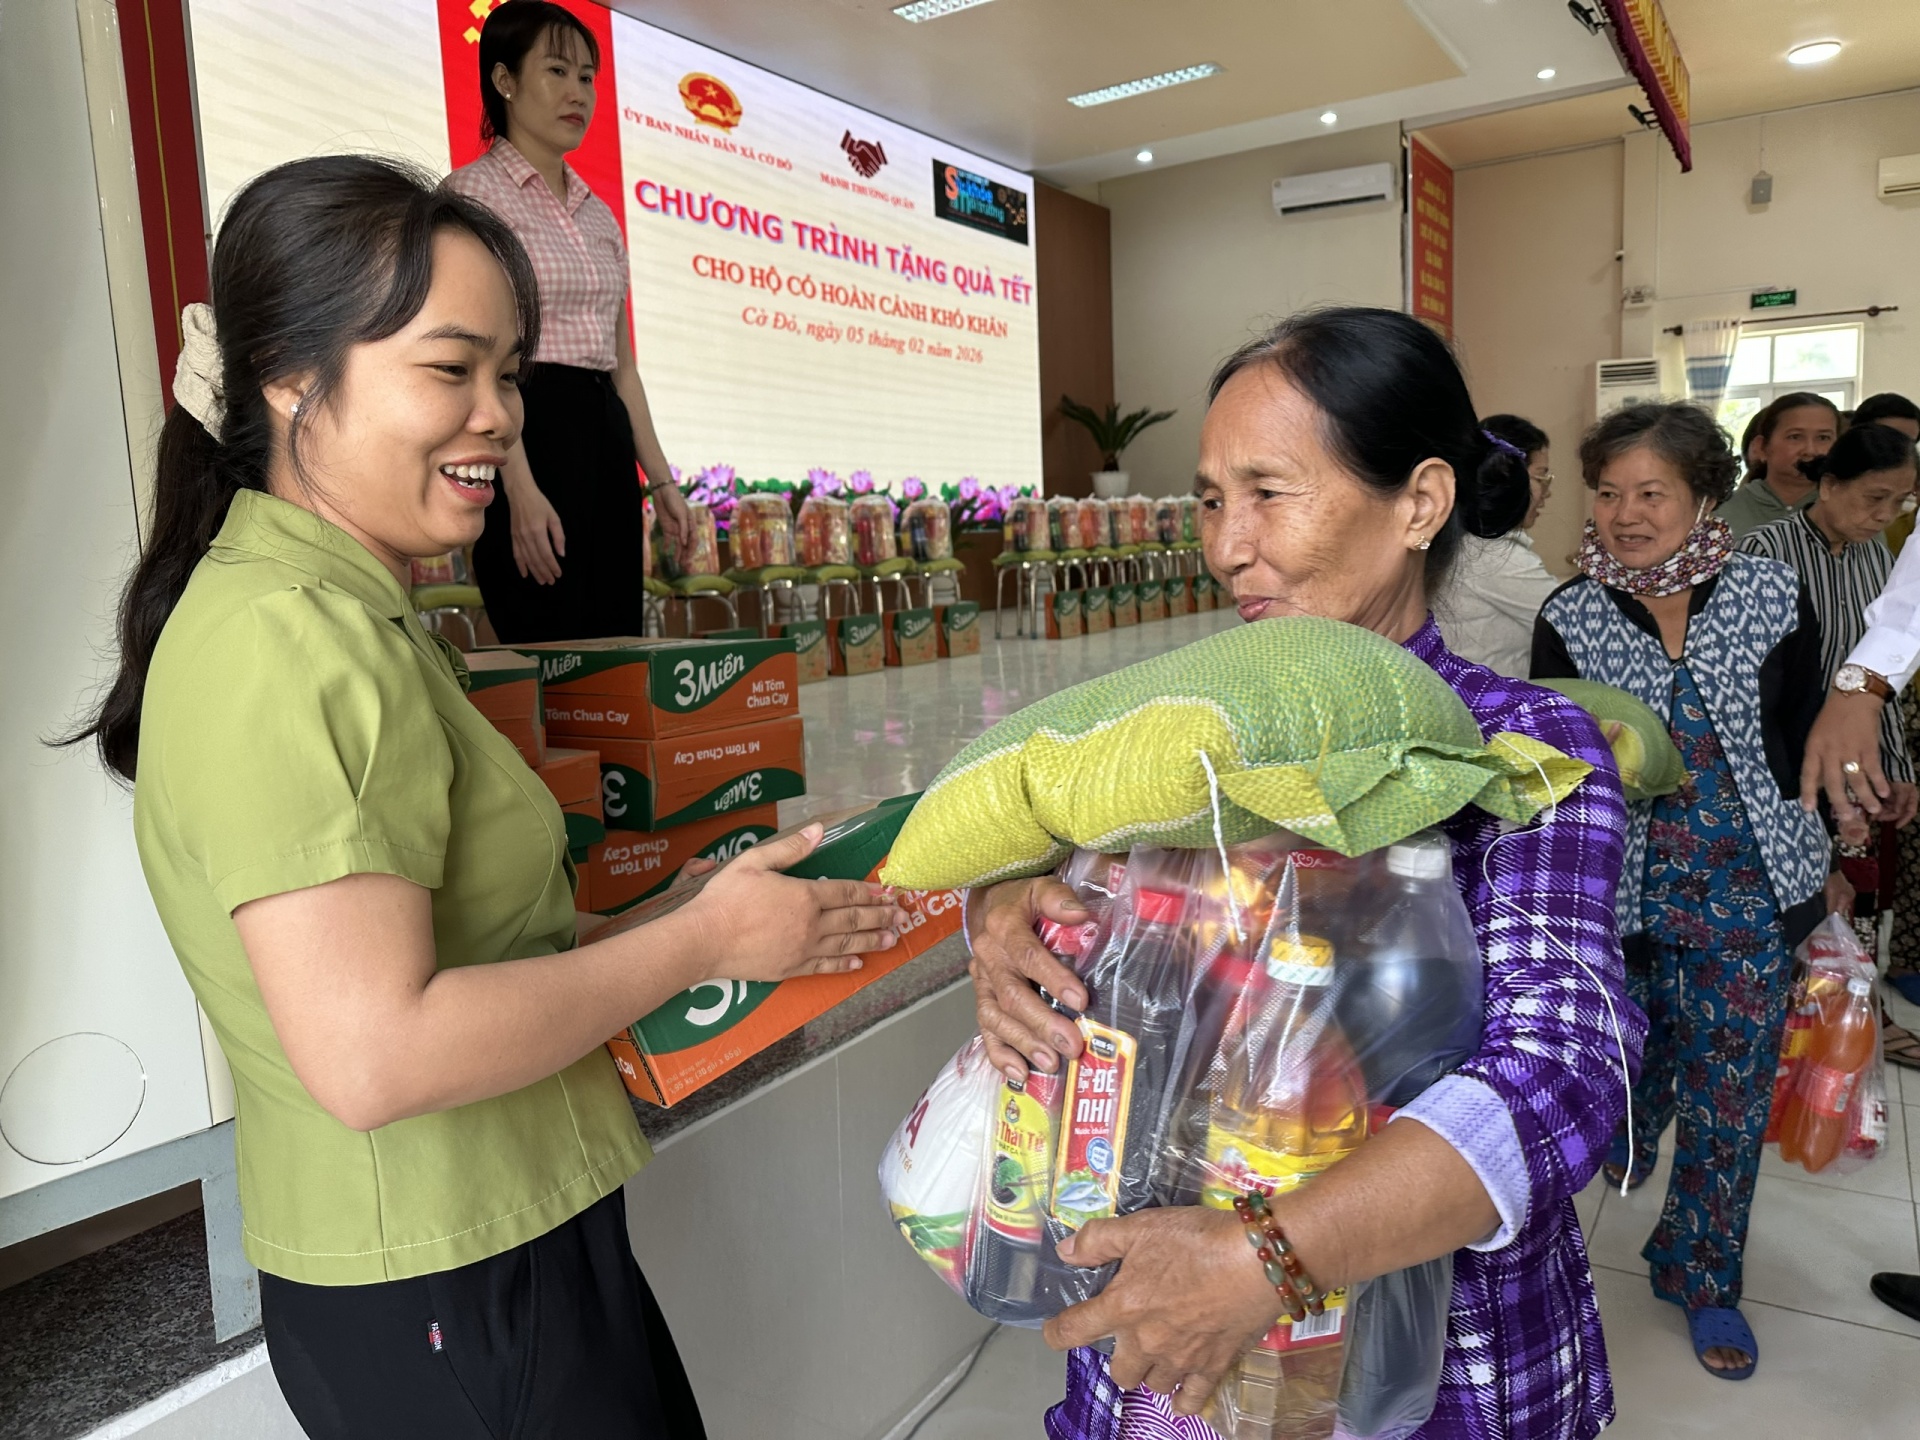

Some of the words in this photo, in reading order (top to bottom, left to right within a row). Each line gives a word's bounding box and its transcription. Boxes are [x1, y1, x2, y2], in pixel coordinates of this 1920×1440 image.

[645, 115, 672, 133] BAN
[675, 125, 710, 146] NHÂN
[635, 179, 784, 243] CHƯƠNG
[791, 221, 878, 268] TRÌNH
[885, 244, 948, 283] TẶNG
[952, 265, 996, 297] QUÀ
[999, 273, 1032, 305] TẾT
[692, 254, 745, 285] CHO
[749, 264, 782, 296] HỘ
[787, 274, 817, 299] CÓ
[820, 282, 876, 311] HOÀN
[879, 294, 928, 323] CẢNH
[930, 306, 965, 330] KHÓ
[966, 314, 1008, 339] KHĂN
[742, 306, 769, 327] Cờ
[806, 321, 843, 344] ngày
[846, 325, 865, 344] 05
[868, 328, 906, 355] tháng
[908, 335, 925, 355] 02
[927, 342, 953, 359] năm
[956, 344, 984, 364] 2026
[531, 653, 582, 683] Miền
[764, 678, 785, 692] Tôm
[746, 694, 771, 709] Chua
[771, 692, 790, 706] Cay
[545, 708, 571, 721] Tôm
[572, 708, 604, 722] Chua
[606, 710, 630, 726] Cay
[673, 751, 695, 765] Cay
[696, 747, 724, 761] Chua
[724, 743, 748, 756] Tôm
[602, 846, 632, 864] Cay
[632, 838, 669, 856] Chua
[610, 859, 642, 877] Tôm
[1092, 1065, 1118, 1097] ĐỆ
[430, 1321, 443, 1351] FASHION
